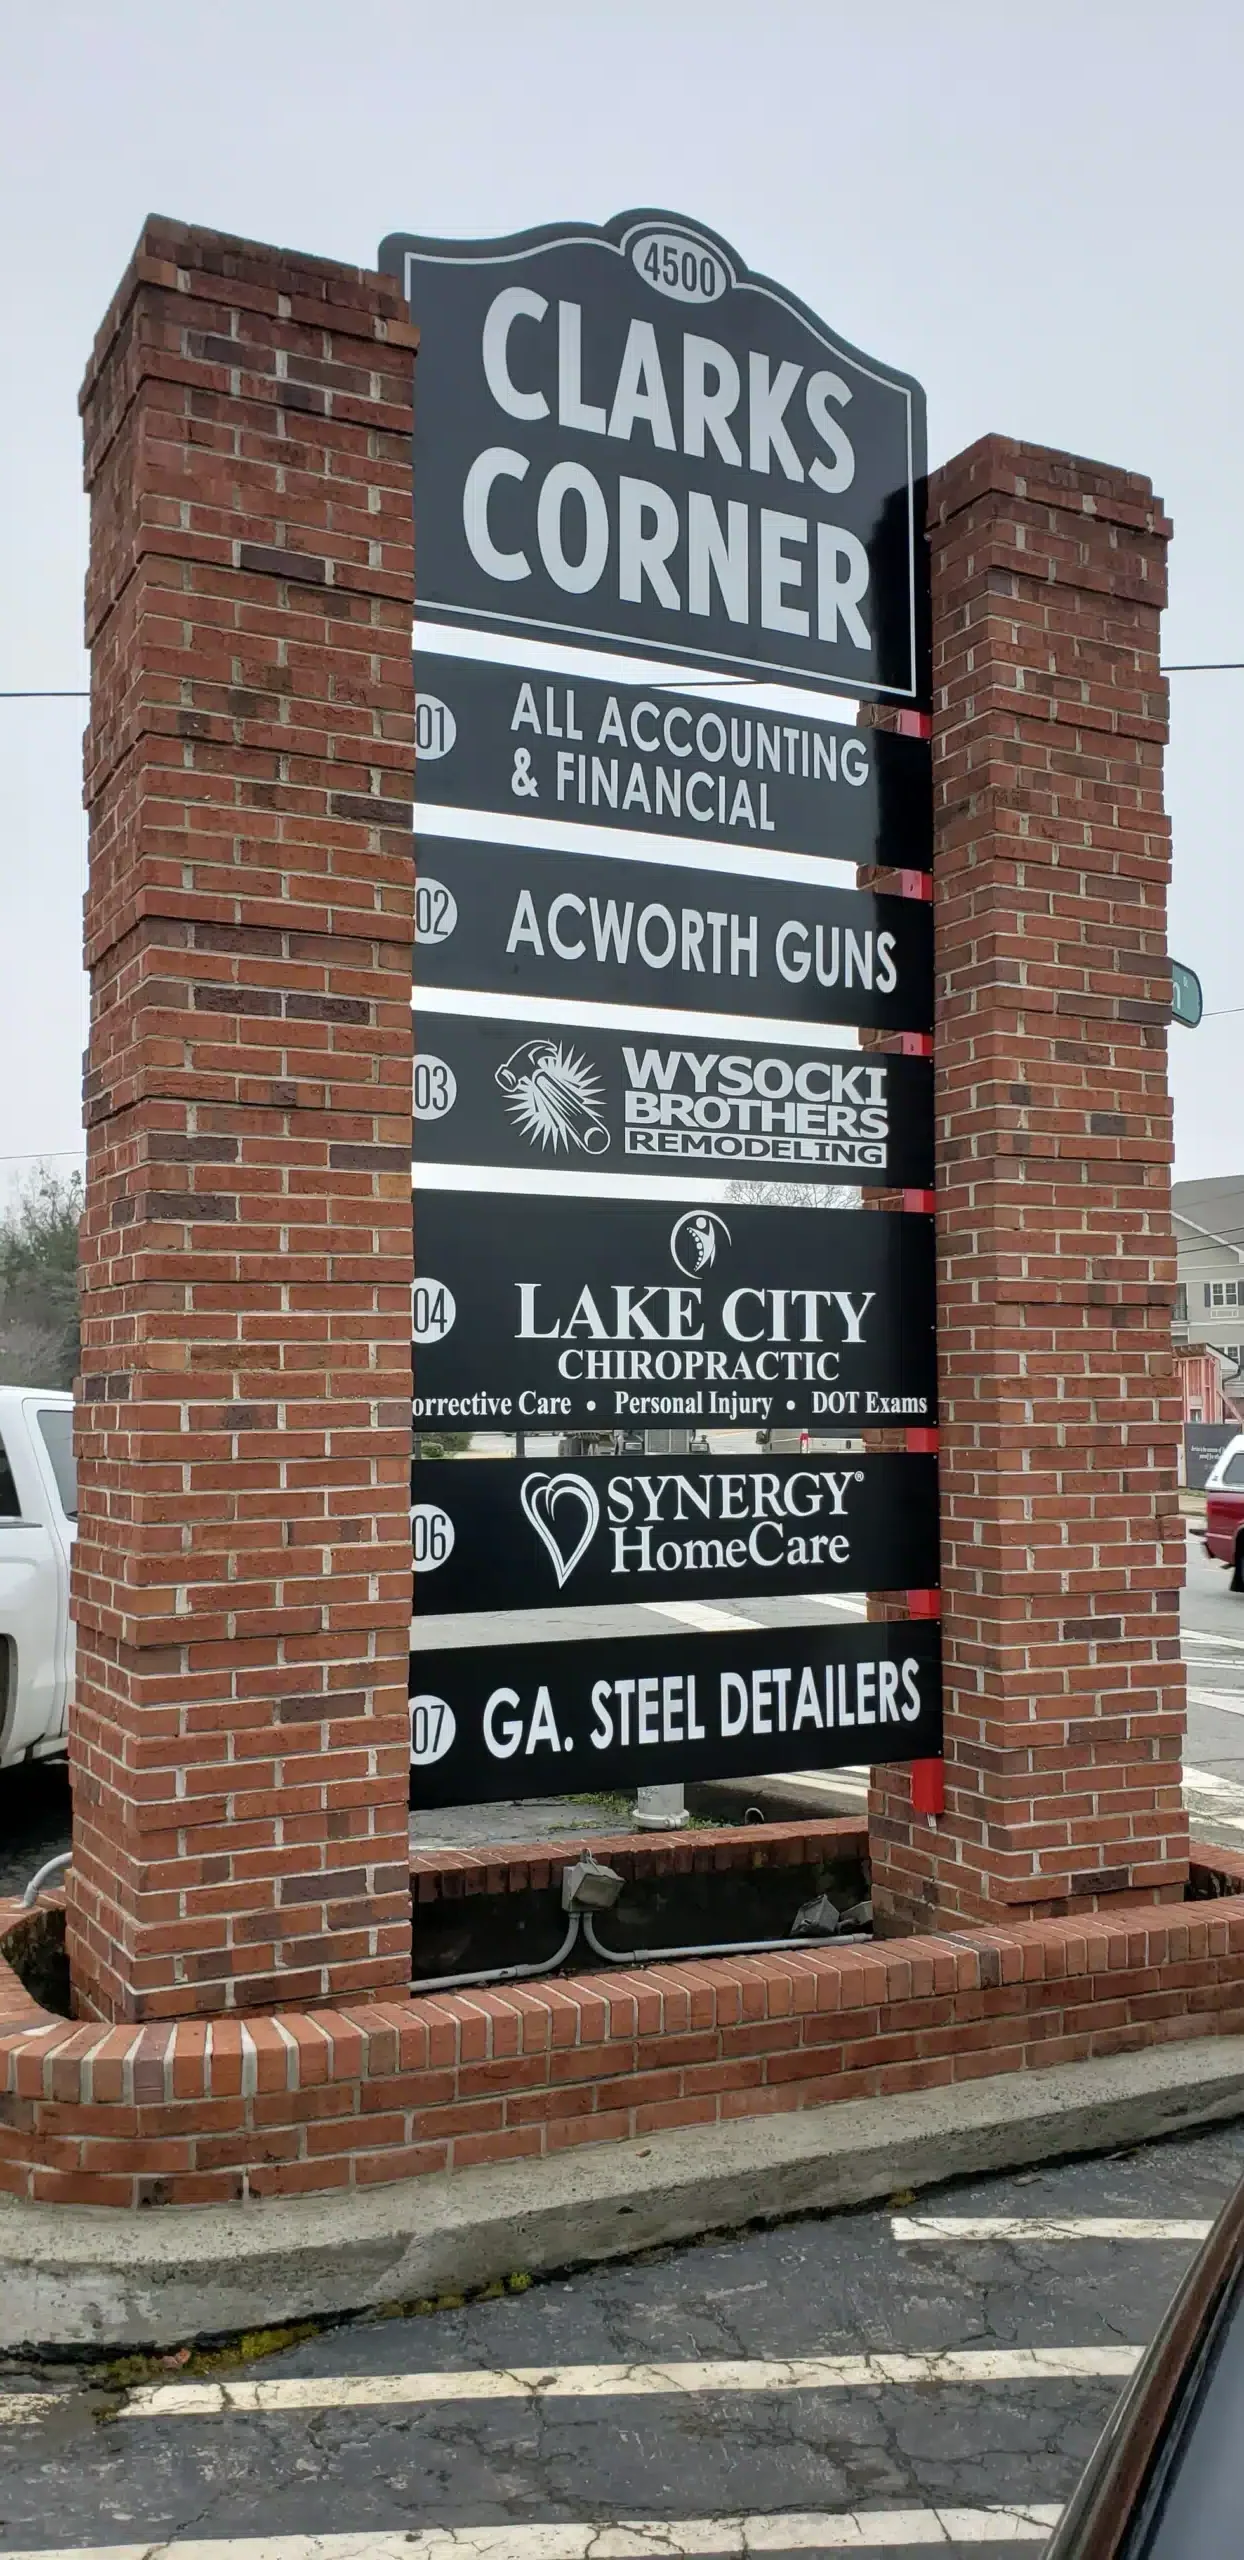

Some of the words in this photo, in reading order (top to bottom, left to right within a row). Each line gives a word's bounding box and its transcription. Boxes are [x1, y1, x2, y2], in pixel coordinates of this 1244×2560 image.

[643, 243, 716, 297] 4500
[482, 286, 856, 494] CLARKS
[463, 446, 872, 651] CORNER
[416, 704, 445, 752] 01
[510, 682, 583, 741] ALL
[598, 696, 869, 787] ACCOUNTING
[511, 747, 539, 797] &
[557, 751, 775, 831] FINANCIAL
[416, 887, 449, 935] 02
[506, 890, 758, 978] ACWORTH
[775, 920, 897, 993] GUNS
[414, 1065, 448, 1109] 03
[622, 1046, 887, 1106] WYSOCKI
[625, 1092, 889, 1139] BROTHERS
[629, 1132, 883, 1165] REMODELING
[414, 1288, 447, 1333] 04
[514, 1283, 704, 1341] LAKE
[722, 1288, 876, 1343] CITY
[558, 1349, 840, 1380] CHIROPRACTIC
[412, 1391, 512, 1416] orrective
[519, 1390, 571, 1415] Care
[614, 1391, 702, 1414] Personal
[708, 1391, 773, 1420] Injury
[812, 1391, 859, 1413] DOT
[865, 1391, 927, 1413] Exams
[413, 1514, 446, 1561] 06
[609, 1521, 850, 1573] HomeCare
[413, 1704, 445, 1754] 07
[483, 1687, 573, 1758] GA.
[591, 1675, 704, 1749] STEEL
[721, 1657, 920, 1737] DETAILERS
